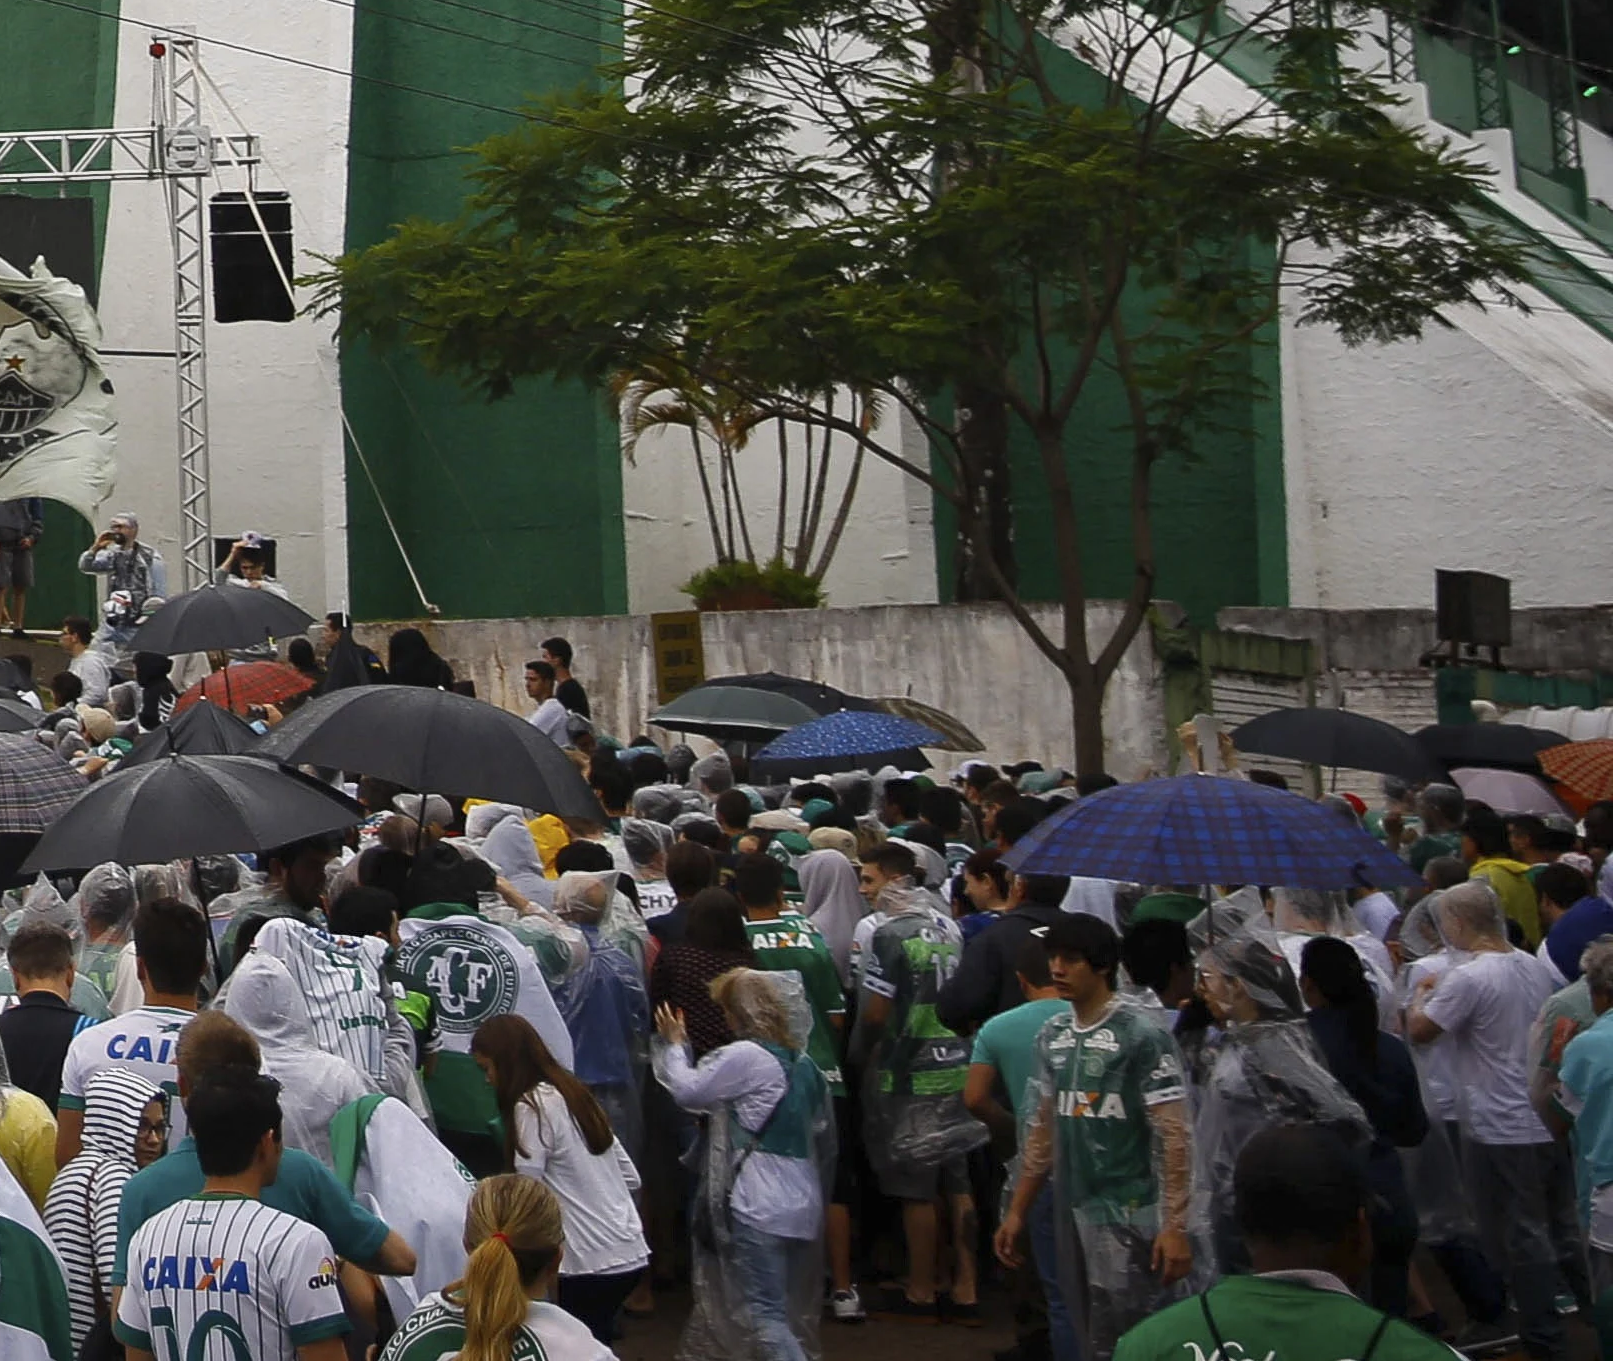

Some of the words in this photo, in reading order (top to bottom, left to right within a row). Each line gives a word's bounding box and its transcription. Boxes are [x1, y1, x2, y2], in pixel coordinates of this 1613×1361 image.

[753, 932, 814, 949] AIXA
[107, 1034, 171, 1064] CAI
[143, 1255, 252, 1295] CAIXA
